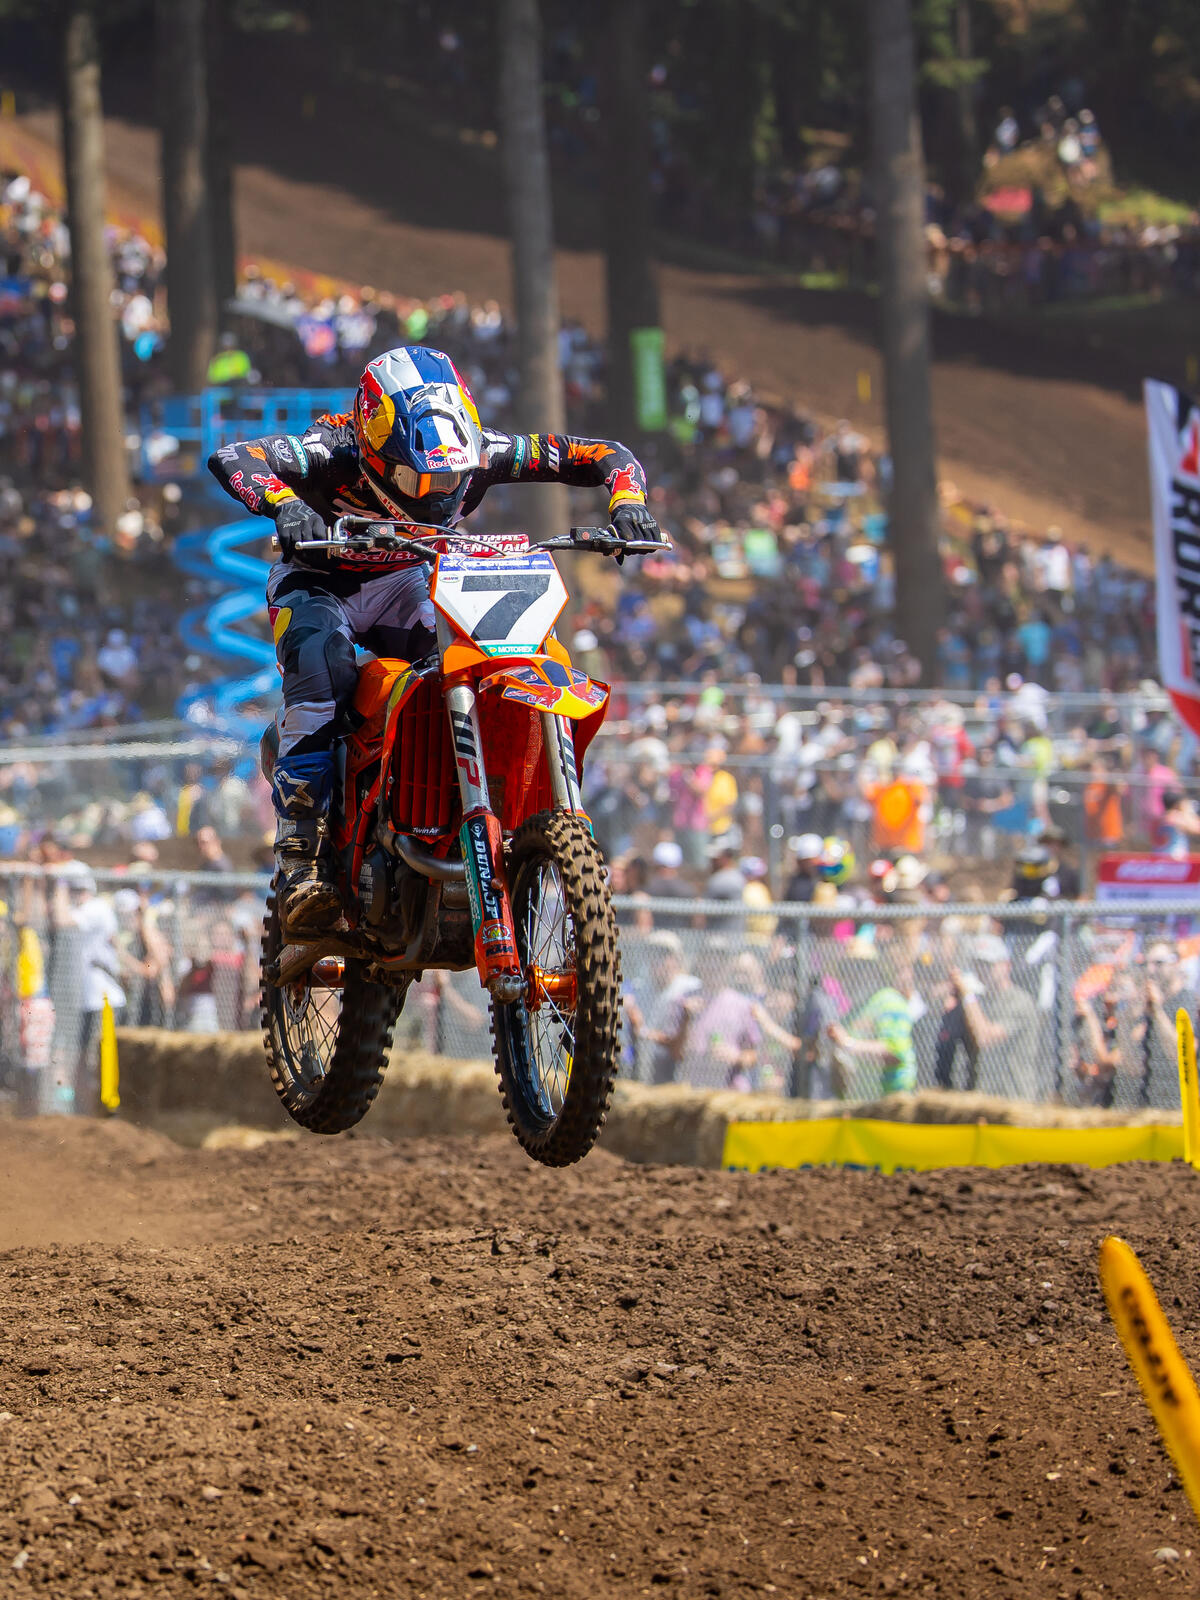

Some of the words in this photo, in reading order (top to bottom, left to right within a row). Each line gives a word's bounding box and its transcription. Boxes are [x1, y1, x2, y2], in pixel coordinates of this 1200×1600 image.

[428, 457, 449, 469] Red
[450, 455, 469, 466] Bull
[229, 470, 253, 499] Red
[461, 574, 551, 640] 7
[498, 645, 534, 653] MOTOREX
[474, 840, 499, 919] DUNLOP
